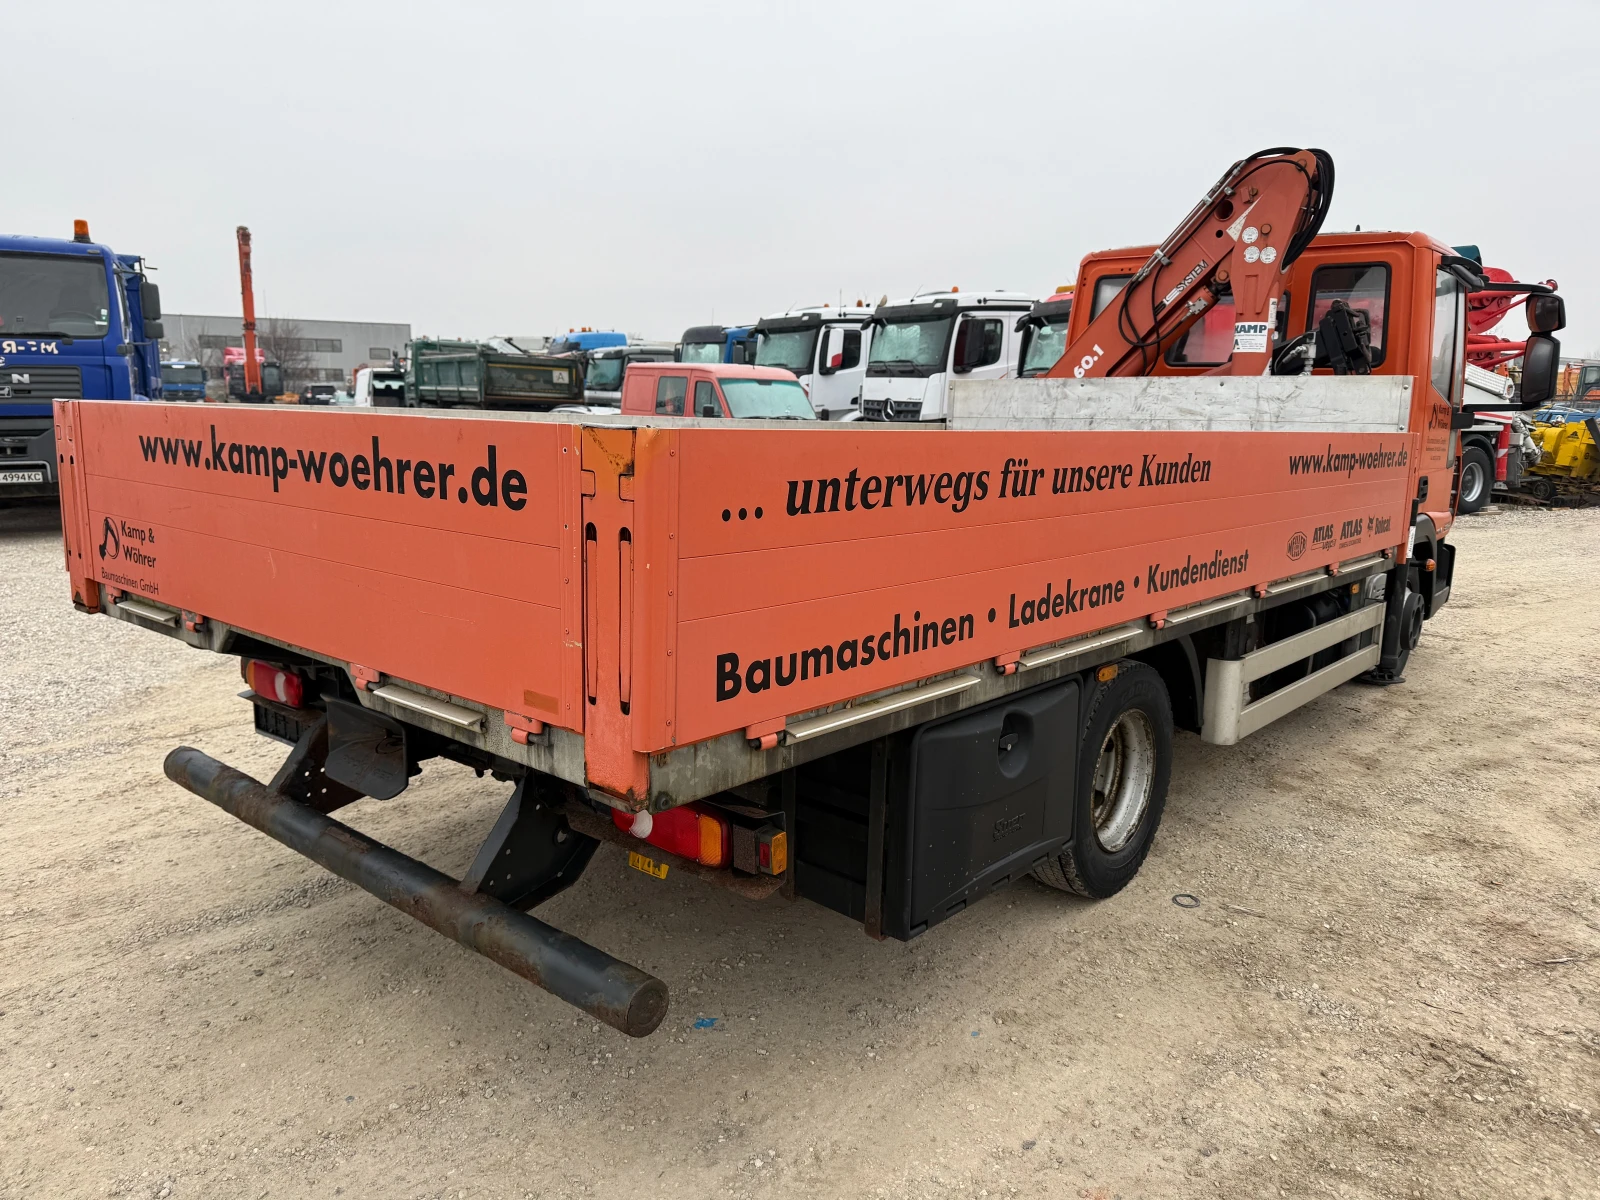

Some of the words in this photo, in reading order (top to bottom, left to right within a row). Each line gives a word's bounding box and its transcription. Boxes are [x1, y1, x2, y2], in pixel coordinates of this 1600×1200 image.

[1073, 343, 1105, 379] 60.1
[138, 425, 528, 511] www.kamp-woehrer.de
[1289, 443, 1408, 479] www.kamp-woehrer.de
[786, 464, 990, 516] unterwegs
[998, 458, 1045, 499] für
[1052, 462, 1135, 496] unsere
[1137, 453, 1212, 487] Kunden
[121, 520, 146, 546] Kamp
[148, 528, 155, 544] &
[1312, 524, 1334, 543] ATLAS
[1339, 518, 1363, 540] ATLAS
[122, 544, 156, 568] Wöhrer
[101, 567, 139, 590] Baumaschinen
[139, 578, 160, 596] GmbH
[716, 609, 974, 703] Baumaschinen
[1008, 576, 1125, 629] Ladekrane
[1146, 549, 1249, 594] Kundendienst
